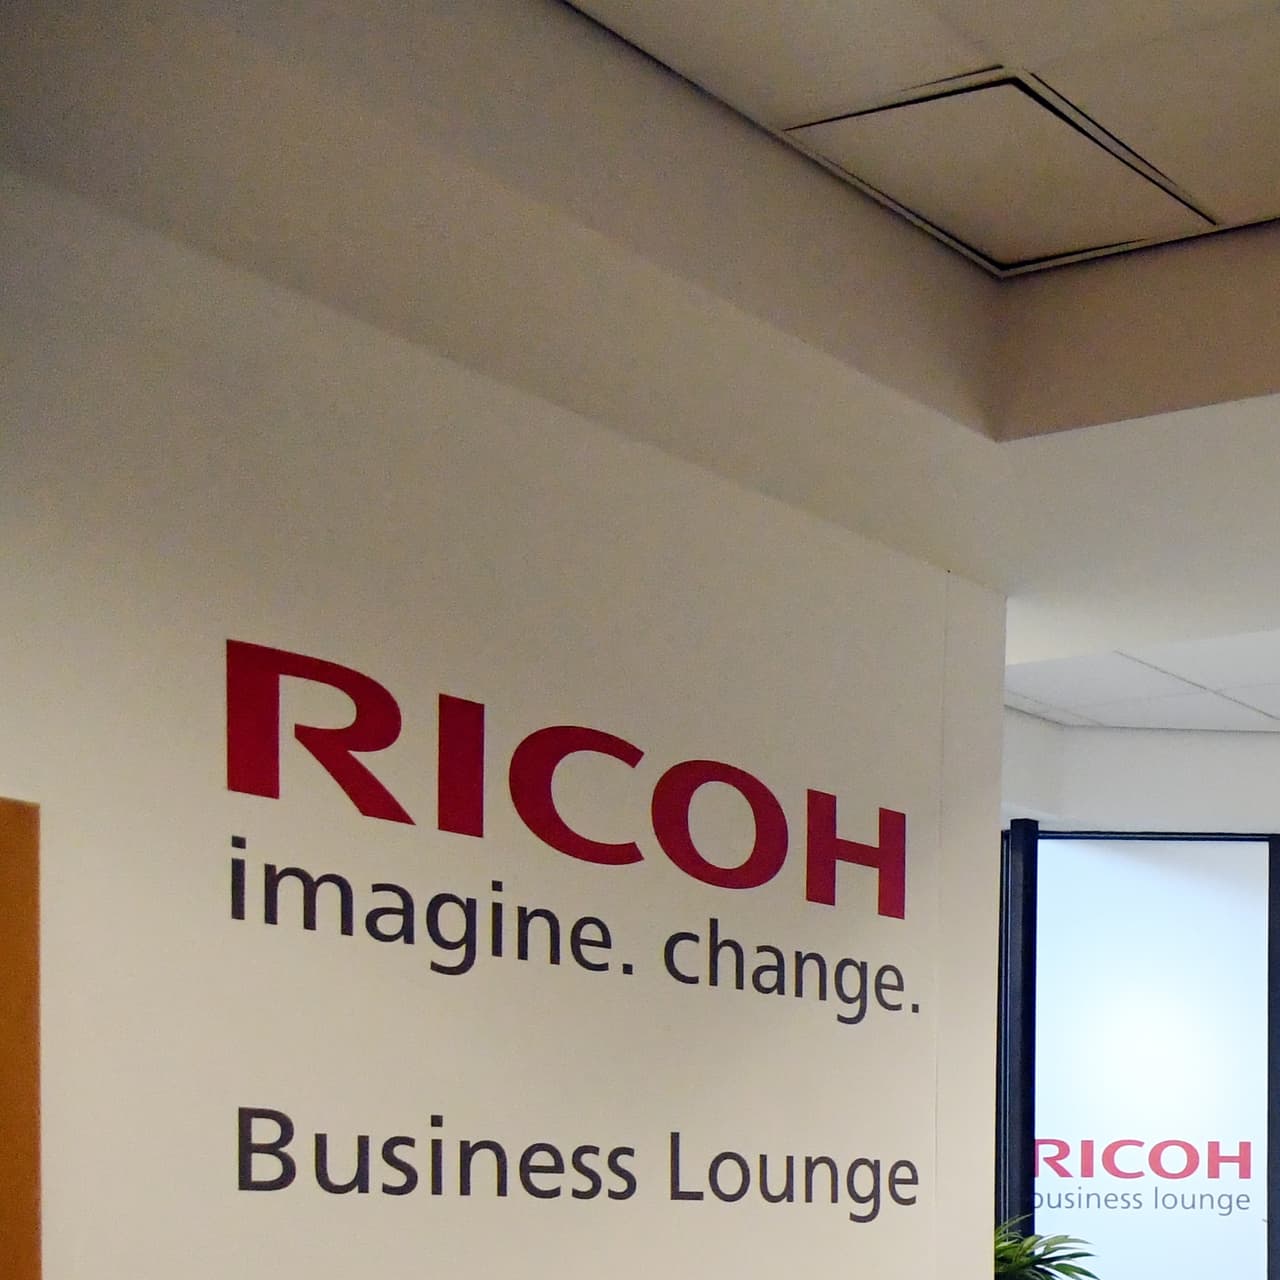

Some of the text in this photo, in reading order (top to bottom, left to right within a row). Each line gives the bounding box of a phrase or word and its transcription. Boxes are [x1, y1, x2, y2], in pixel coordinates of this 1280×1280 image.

[227, 640, 905, 919] RICOH
[230, 836, 920, 1024] imagine. change.
[237, 1106, 920, 1224] Business Lounge
[1034, 1139, 1252, 1180] RICOH
[1154, 1186, 1251, 1216] lounge
